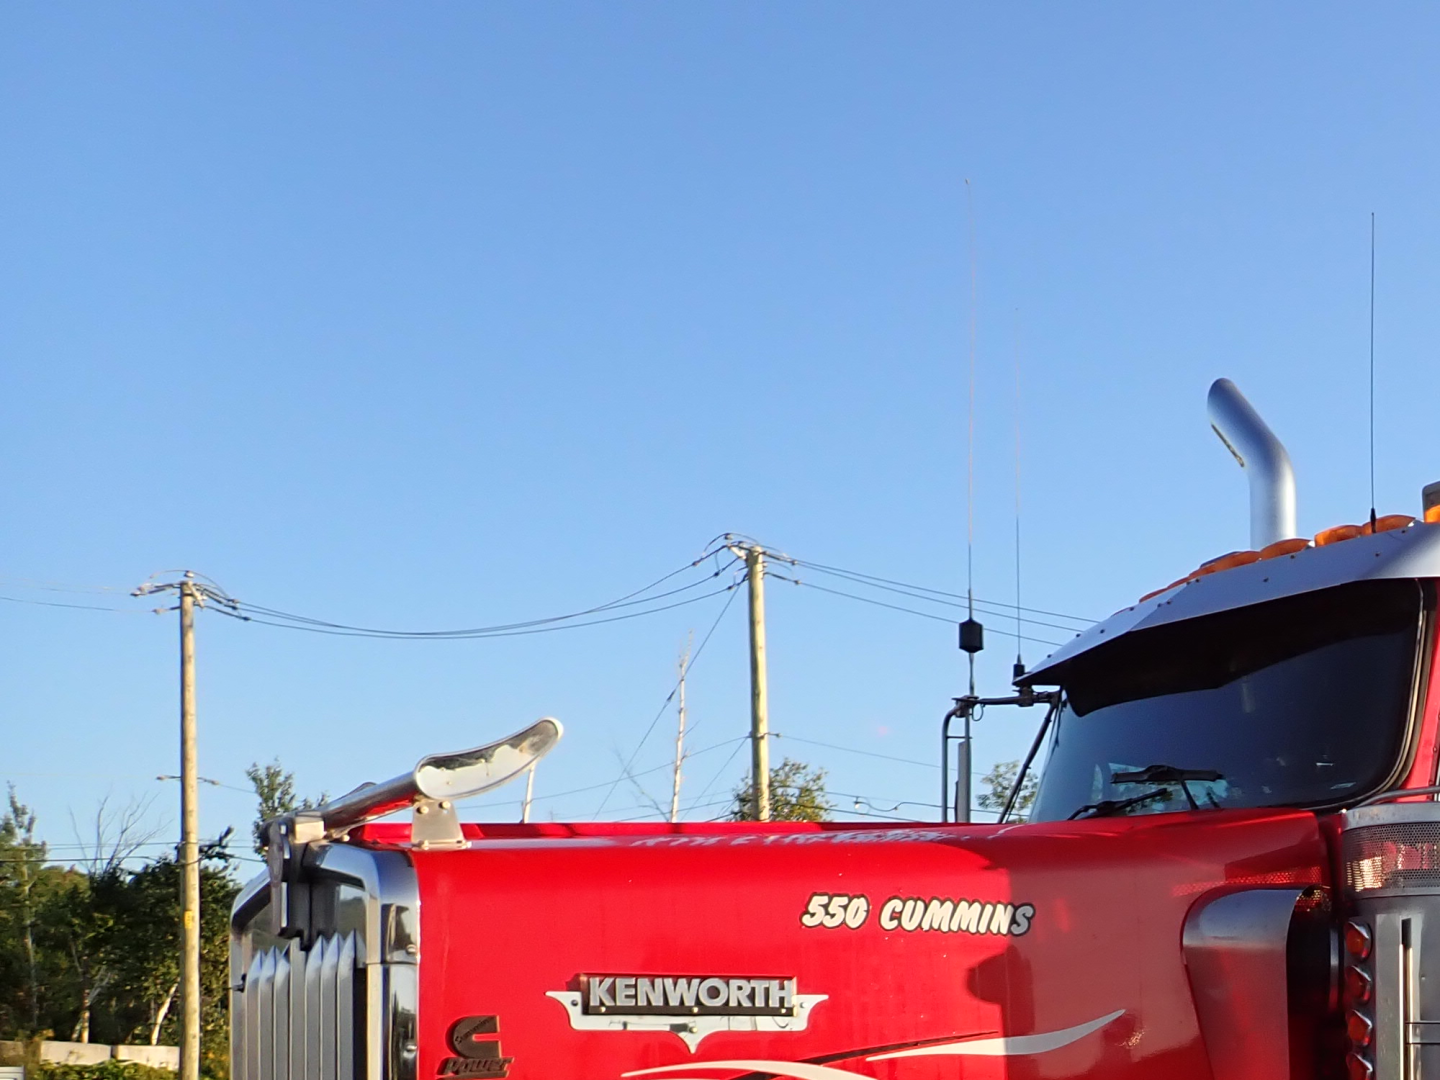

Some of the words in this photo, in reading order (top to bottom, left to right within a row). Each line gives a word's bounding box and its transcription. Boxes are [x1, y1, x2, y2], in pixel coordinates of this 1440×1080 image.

[800, 894, 870, 929] 550
[879, 897, 1035, 936] CUMMINS
[587, 977, 794, 1008] KENWORTH
